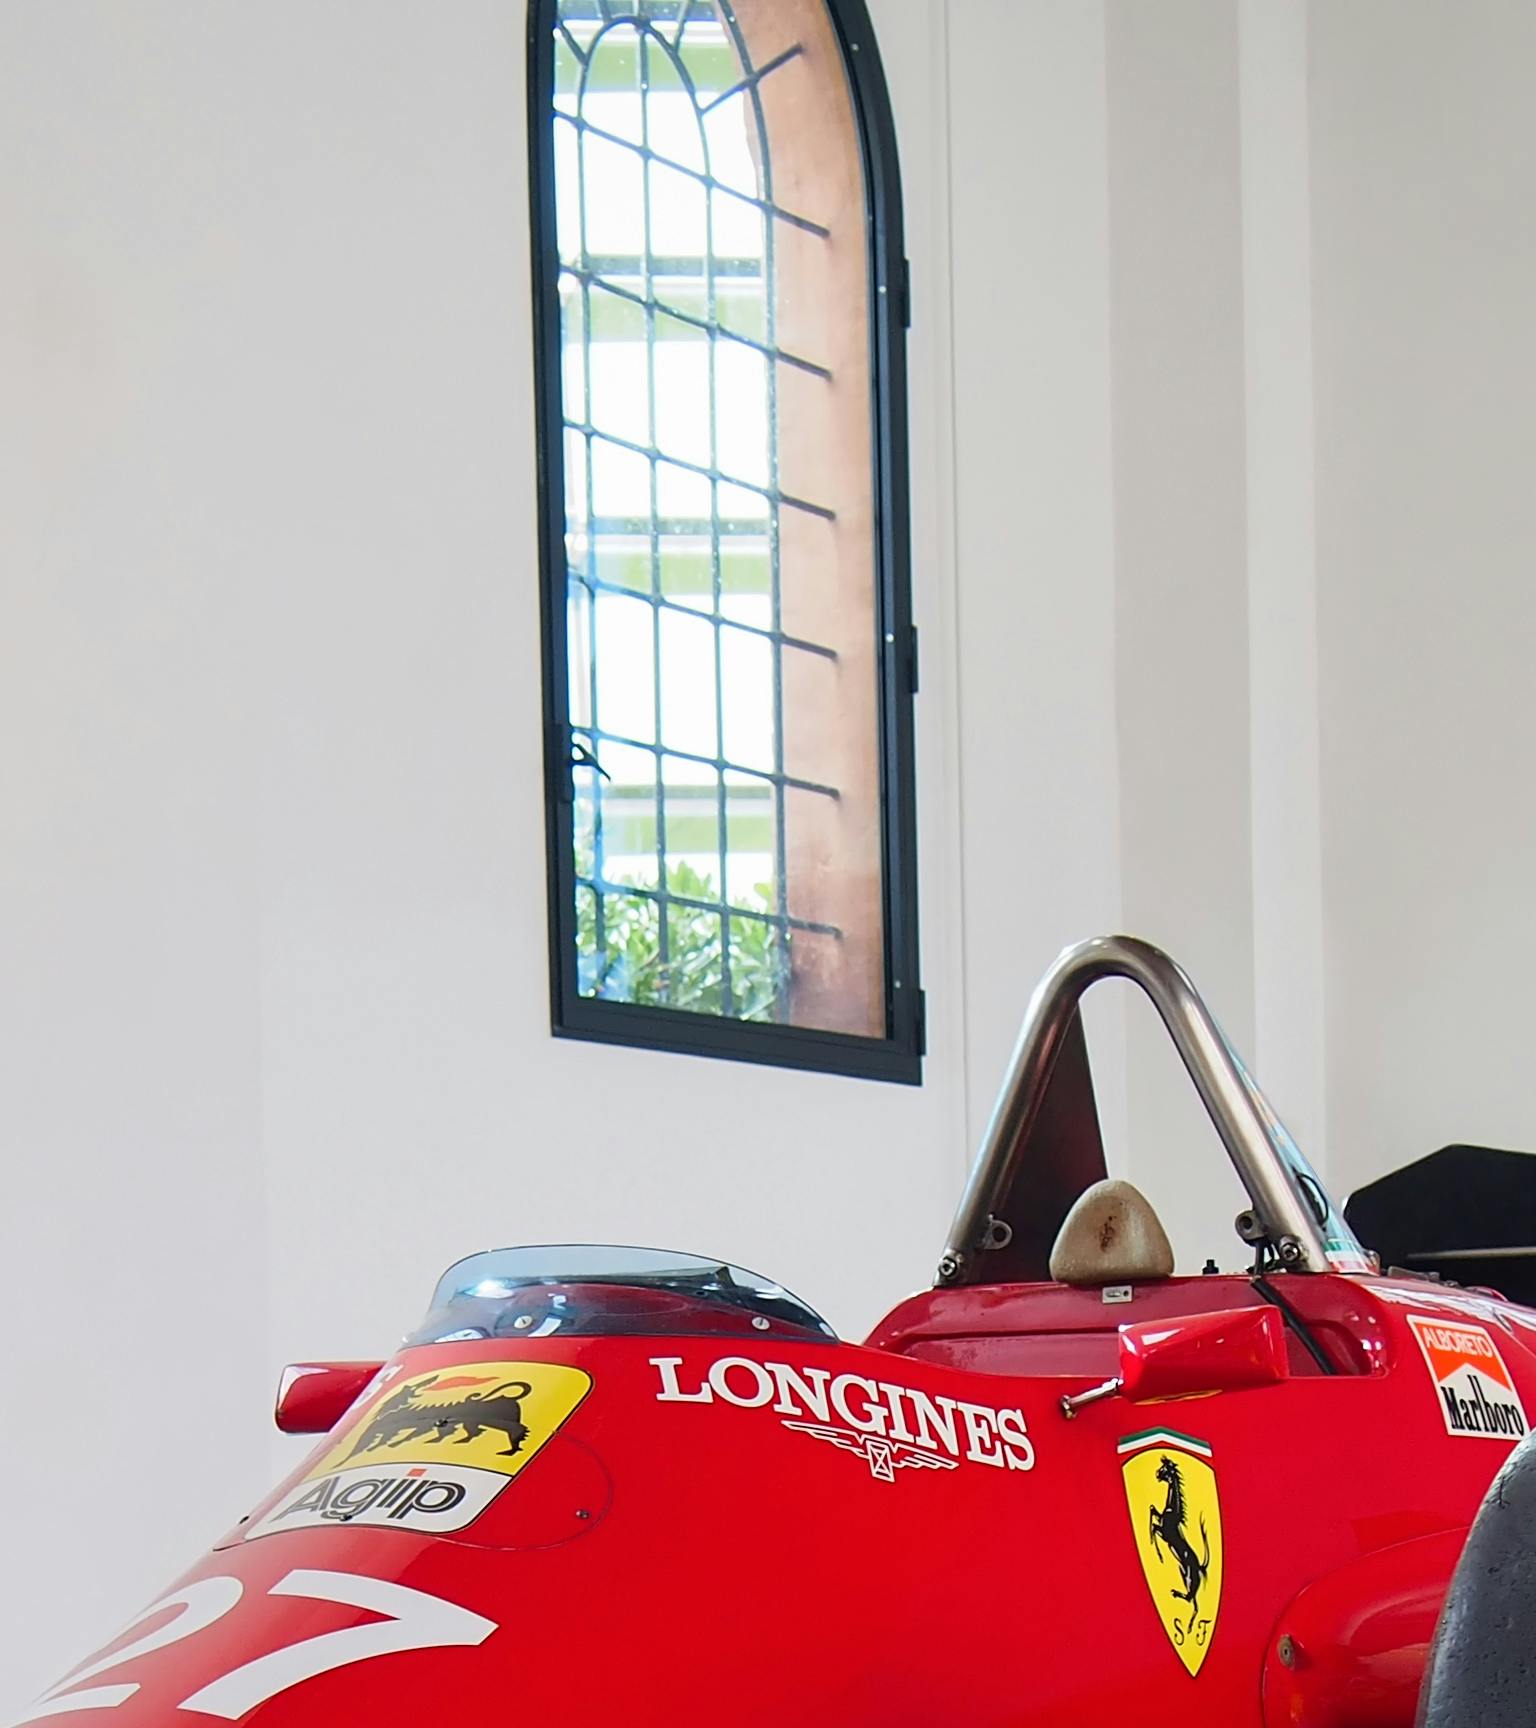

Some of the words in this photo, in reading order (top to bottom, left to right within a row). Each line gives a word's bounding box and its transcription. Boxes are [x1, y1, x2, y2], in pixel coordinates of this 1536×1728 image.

[1421, 1325, 1495, 1358] ALBORETO
[650, 1356, 1035, 1472] LONGINES
[1440, 1374, 1525, 1438] Marlboro
[273, 1469, 466, 1523] Agip
[21, 1569, 499, 1721] 27
